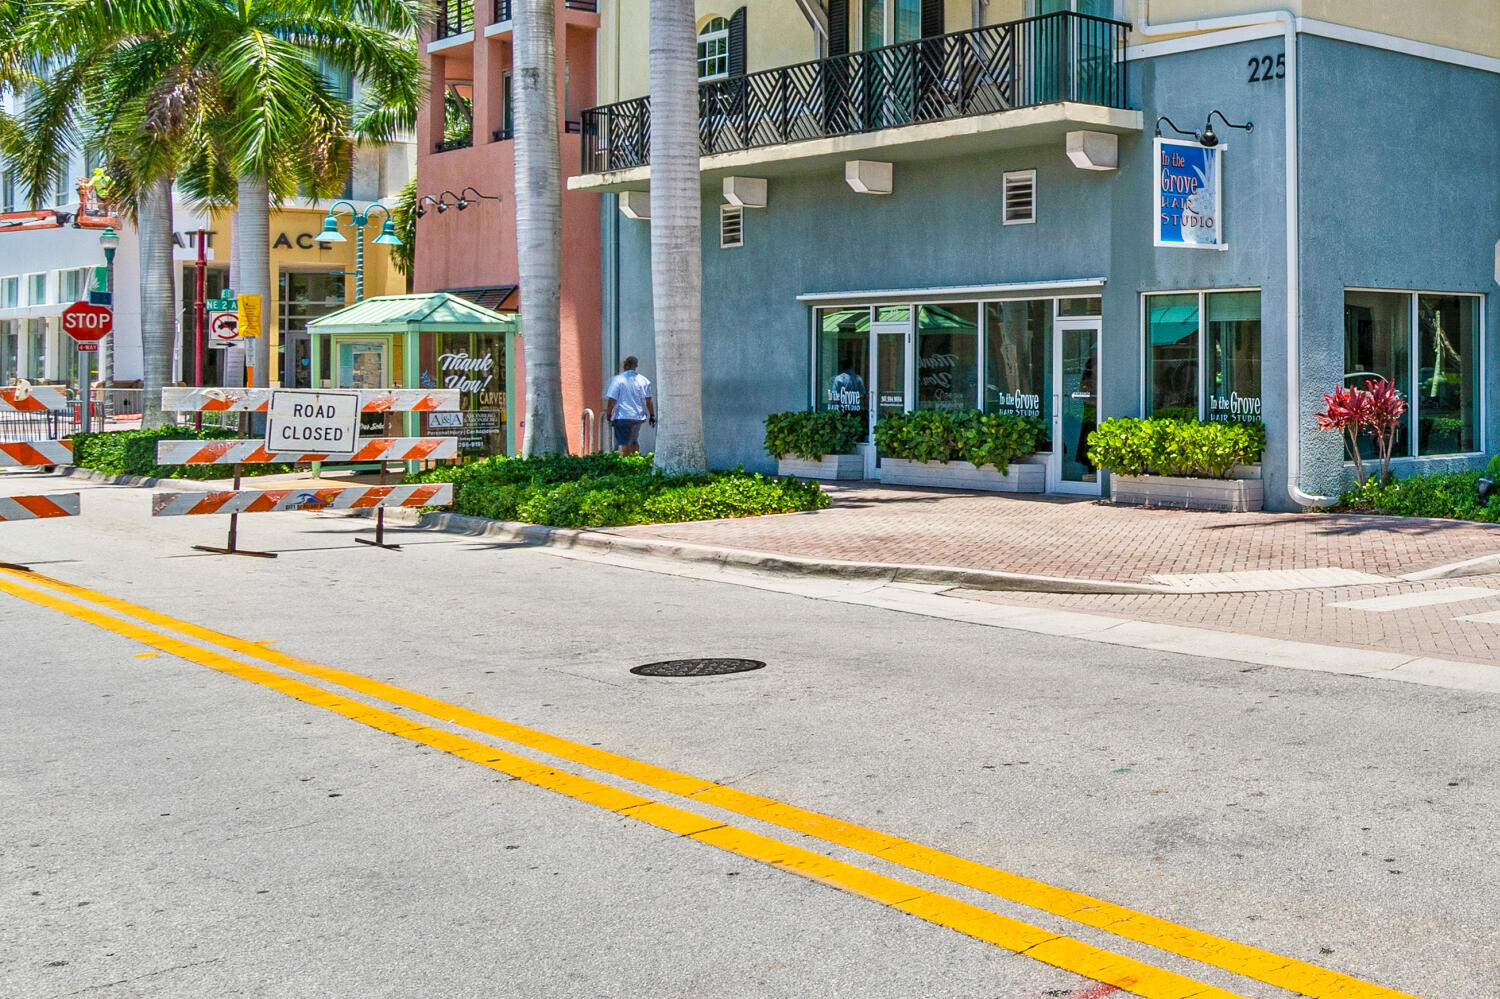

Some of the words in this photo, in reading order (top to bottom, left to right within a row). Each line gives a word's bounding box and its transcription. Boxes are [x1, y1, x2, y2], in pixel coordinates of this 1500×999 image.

[1247, 53, 1285, 83] 225
[1161, 150, 1170, 166] In
[1172, 152, 1185, 168] the
[1161, 167, 1198, 195] Grove
[1161, 195, 1199, 214] HAIR
[1161, 213, 1215, 228] STUDIO
[207, 301, 218, 309] NE
[222, 301, 228, 309] 2
[65, 313, 110, 329] STOP
[79, 344, 97, 352] 4-WAY
[438, 353, 494, 371] Thank
[445, 374, 493, 393] You!
[841, 386, 860, 405] Grove
[1015, 389, 1039, 409] Grove
[1210, 395, 1217, 409] In
[1218, 396, 1229, 410] the
[1230, 391, 1261, 414] Grove
[293, 404, 336, 418] ROAD
[1015, 409, 1040, 417] STUDIO
[1210, 413, 1228, 422] HAIR
[1231, 413, 1261, 423] STUDIO
[430, 414, 462, 426] A&A
[282, 426, 343, 440] CLOSED
